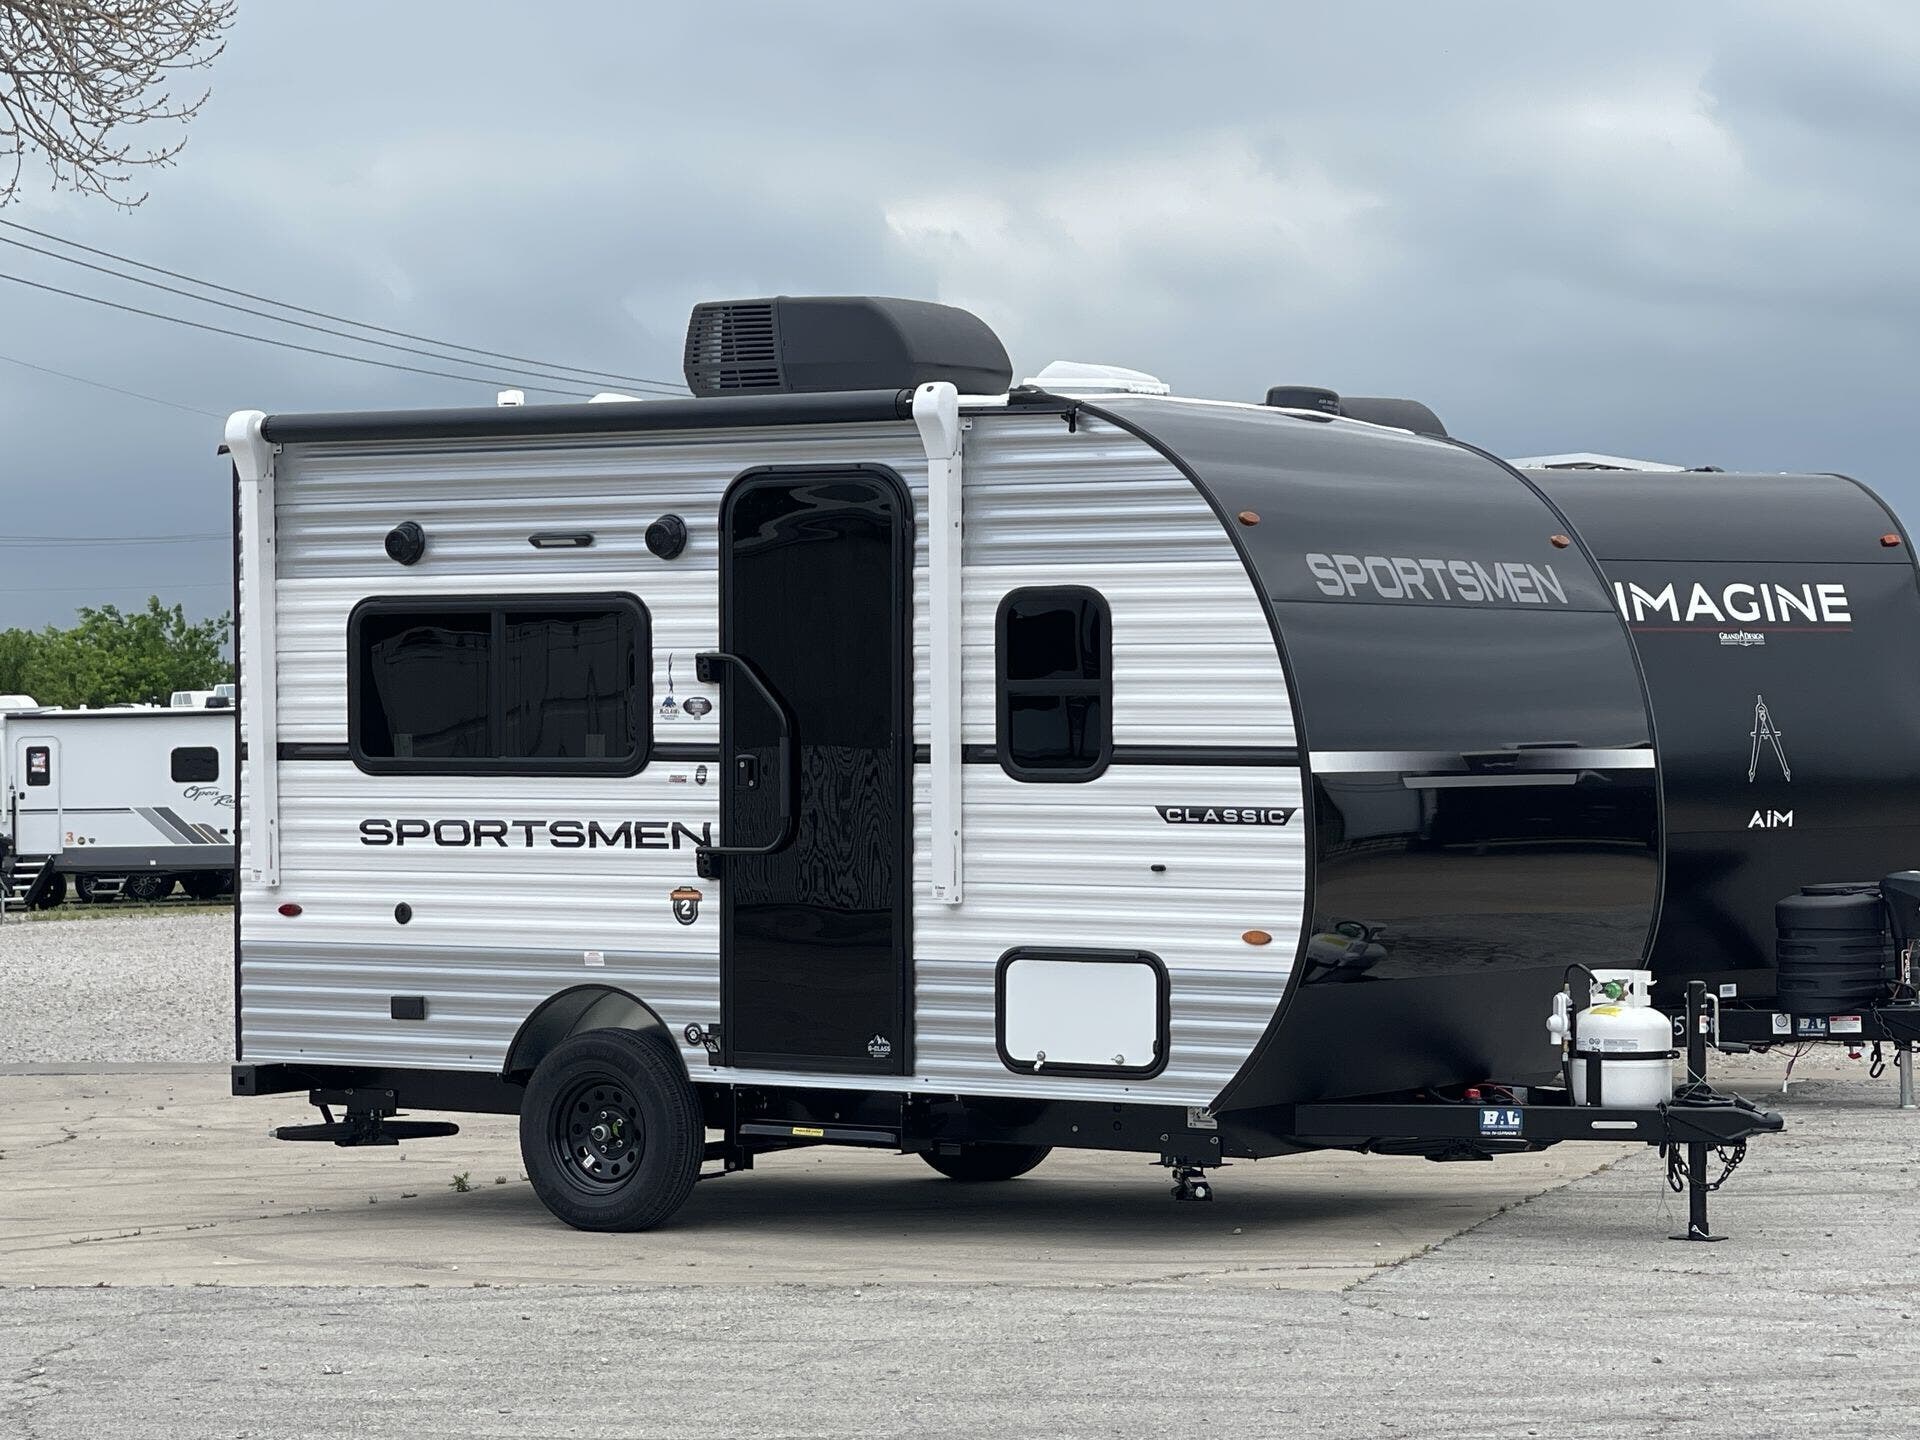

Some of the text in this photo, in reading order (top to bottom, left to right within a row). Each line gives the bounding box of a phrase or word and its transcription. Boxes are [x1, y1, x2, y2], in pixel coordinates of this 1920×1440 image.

[1306, 553, 1568, 603] SPORTSMEN
[1614, 582, 1851, 622] IMAGINE
[183, 786, 222, 801] Open
[1166, 808, 1285, 823] CLASSIC
[359, 819, 711, 850] SPORTSMEN
[680, 899, 691, 915] 2
